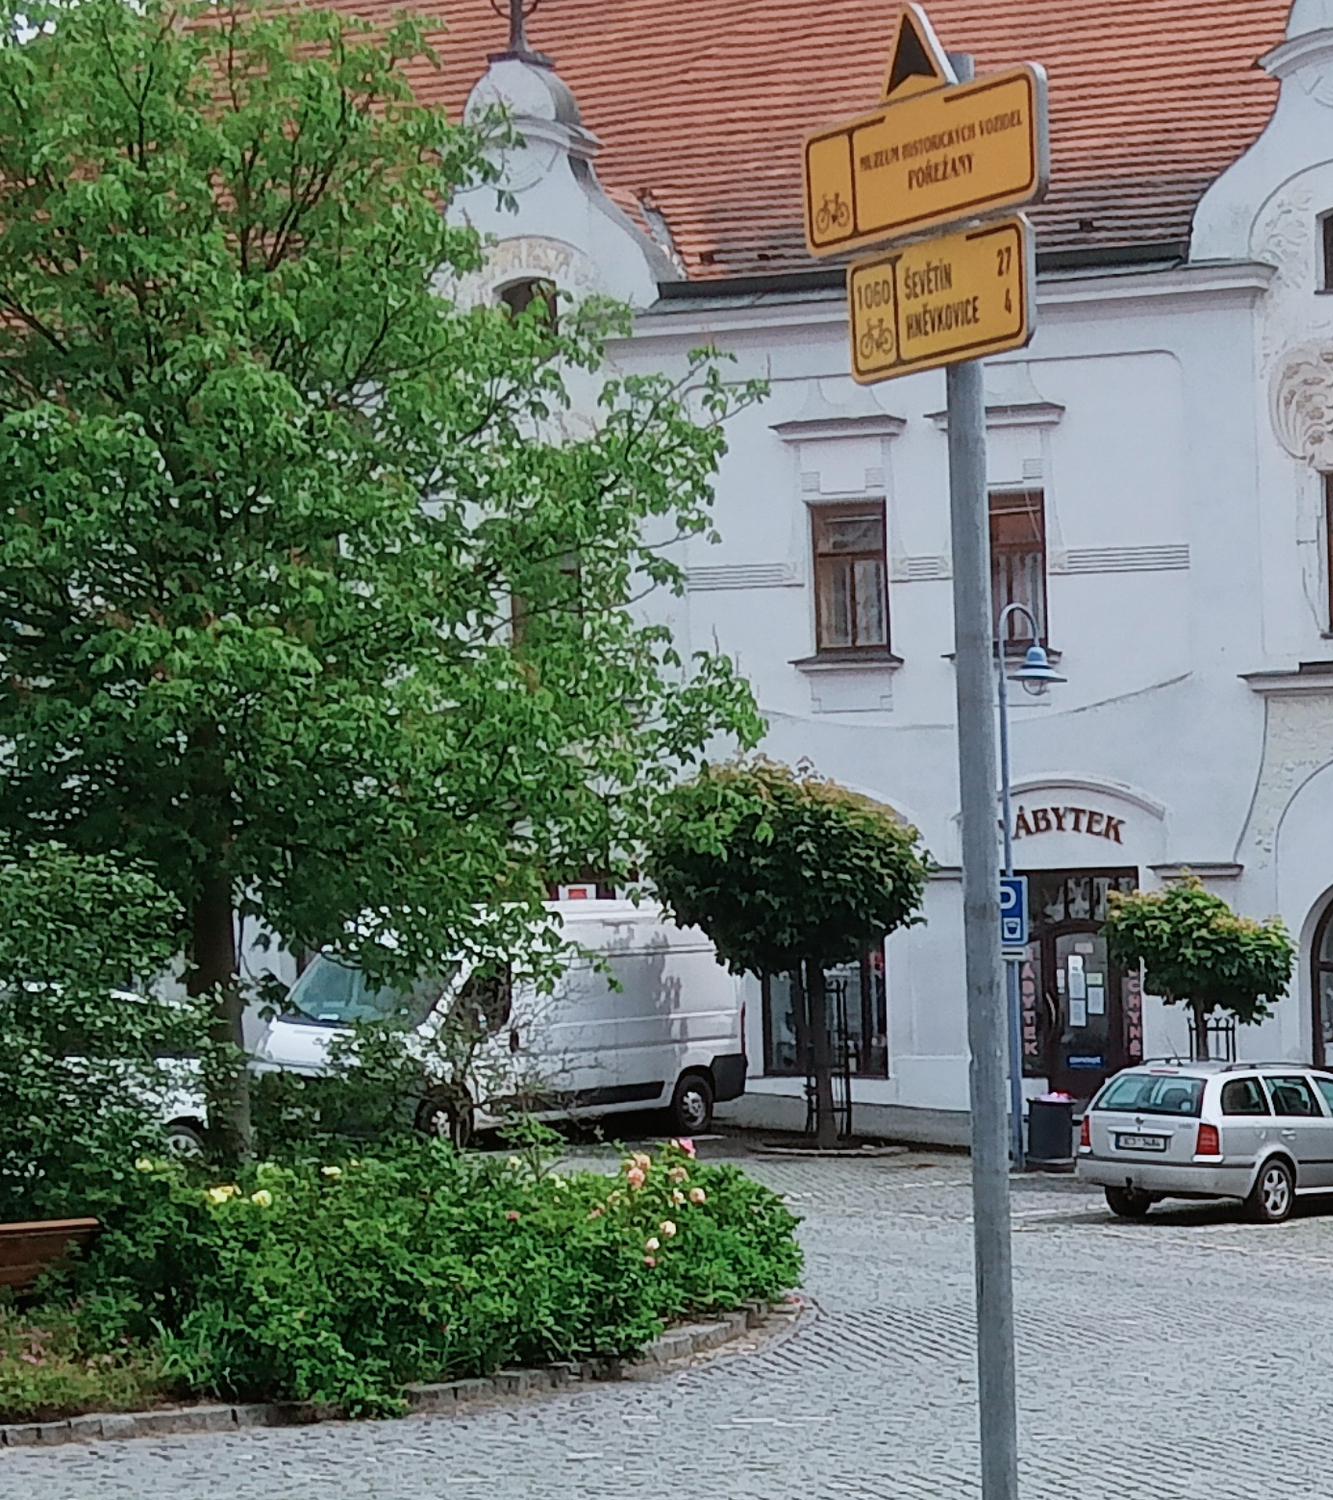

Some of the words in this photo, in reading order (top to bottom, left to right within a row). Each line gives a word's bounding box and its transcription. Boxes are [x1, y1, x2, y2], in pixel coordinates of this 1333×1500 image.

[859, 143, 900, 171] MUZEUM
[901, 122, 976, 161] HISTORICKÝCH
[979, 109, 1023, 137] VOZIDEL
[907, 152, 974, 190] POŘEŽANY
[857, 279, 891, 311] 1060
[904, 259, 953, 301] ŠEVĚTÍN
[996, 246, 1012, 277] 27
[905, 296, 980, 341] HNĚVKOVICE
[1004, 288, 1012, 314] 4
[998, 805, 1126, 846] ÁBYTEK
